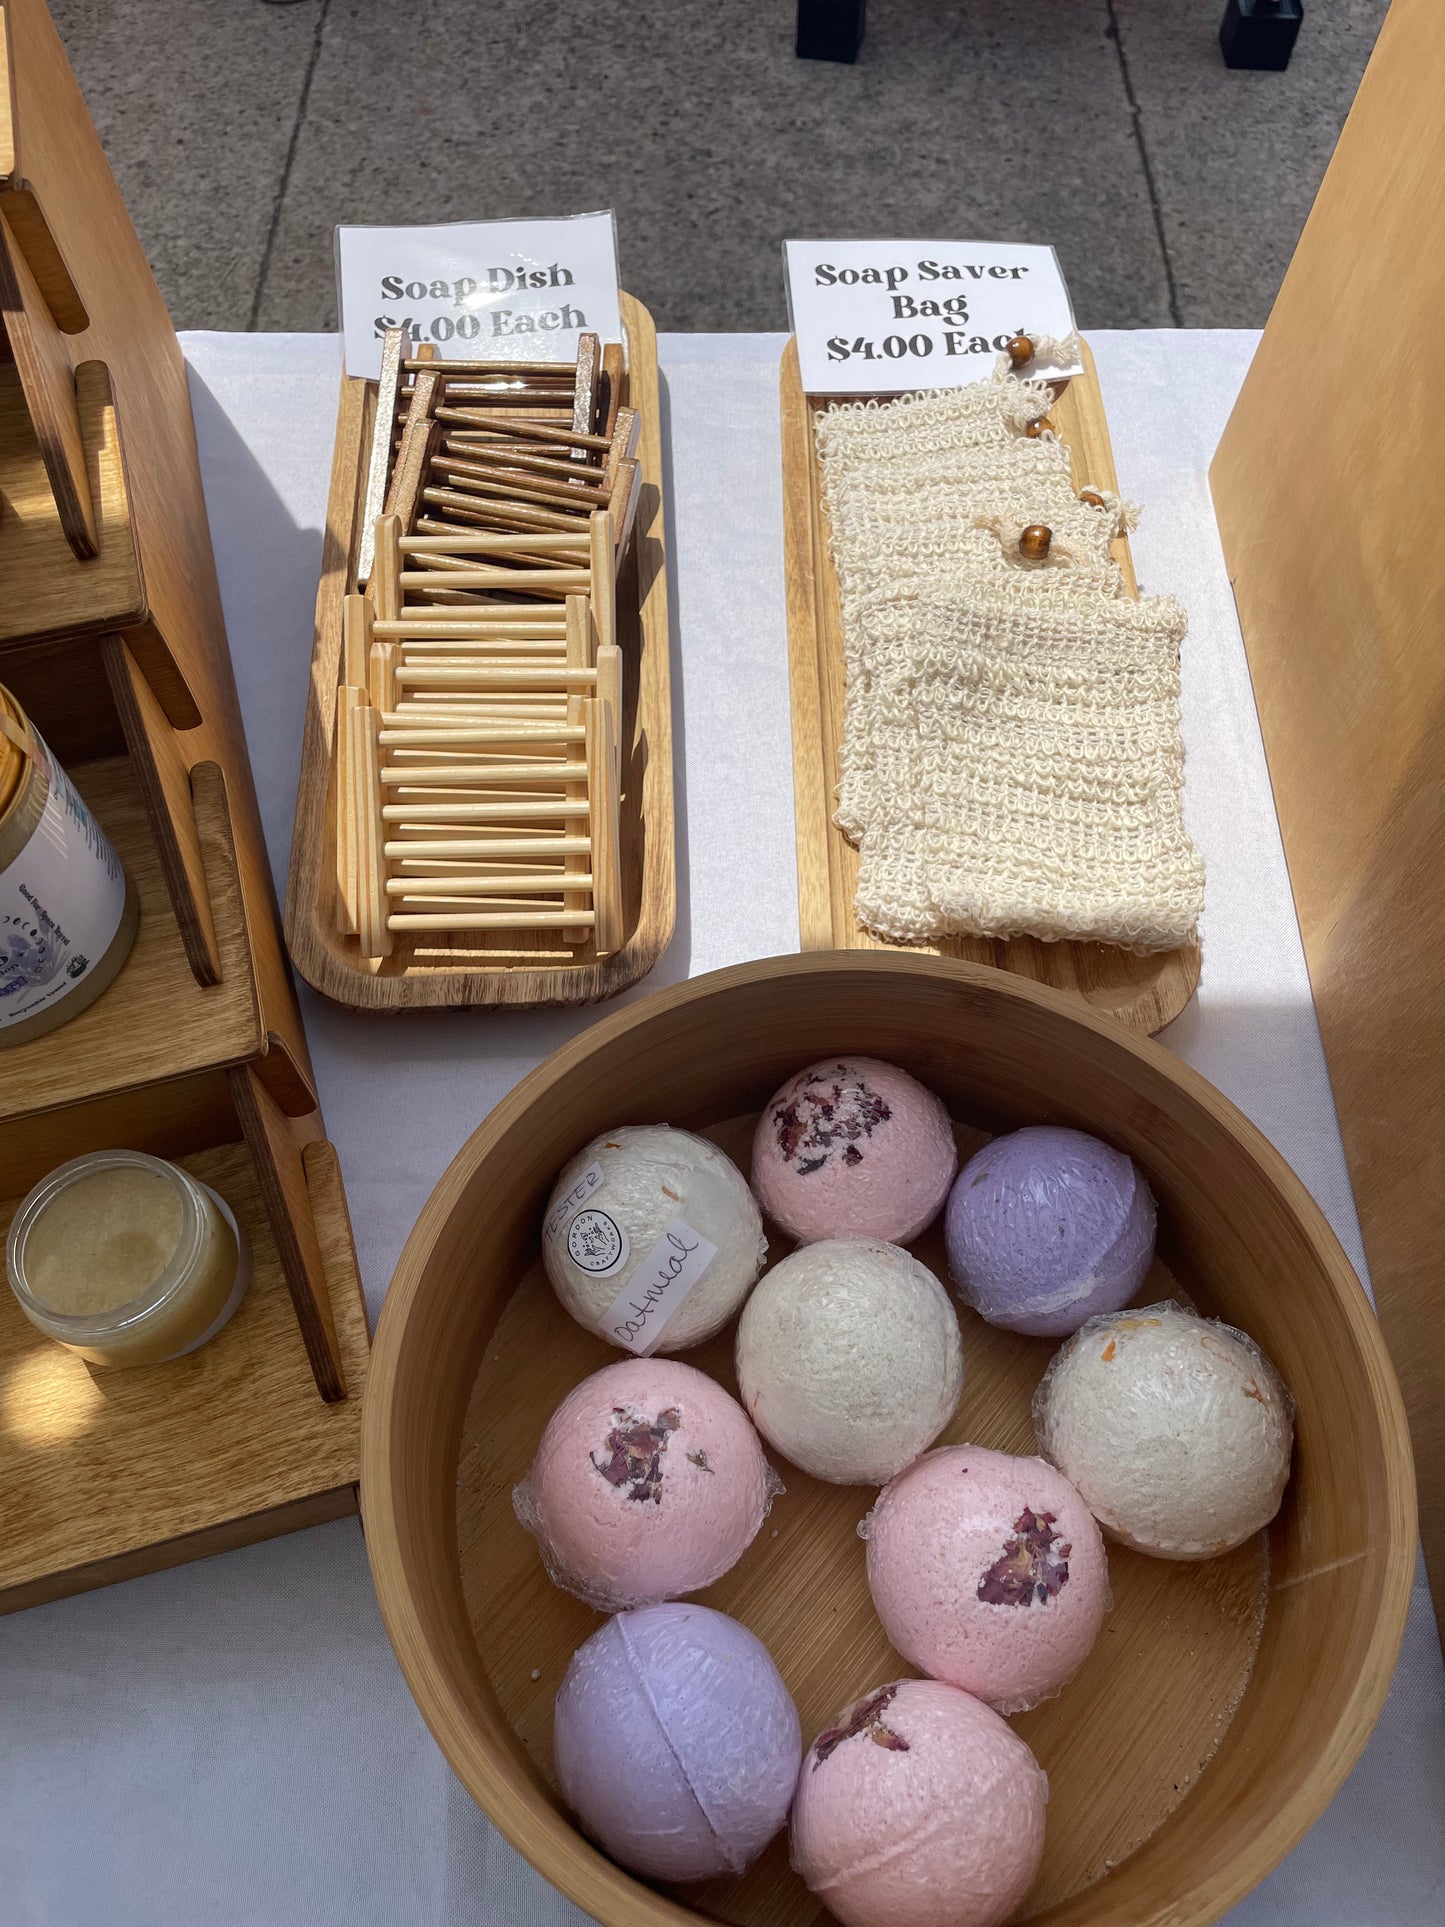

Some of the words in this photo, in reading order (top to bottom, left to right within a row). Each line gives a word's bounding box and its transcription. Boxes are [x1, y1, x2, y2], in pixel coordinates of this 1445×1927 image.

[381, 275, 477, 306] Soap
[488, 263, 575, 293] Dish
[814, 263, 908, 291] Soap
[917, 260, 1029, 281] Saver
[491, 303, 588, 337] Each
[890, 294, 969, 326] Bag
[826, 333, 933, 363] $4.00
[943, 328, 1032, 356] Eac
[19, 884, 34, 902] Good
[545, 1172, 599, 1242] TESTER
[572, 1215, 593, 1257] GORDON
